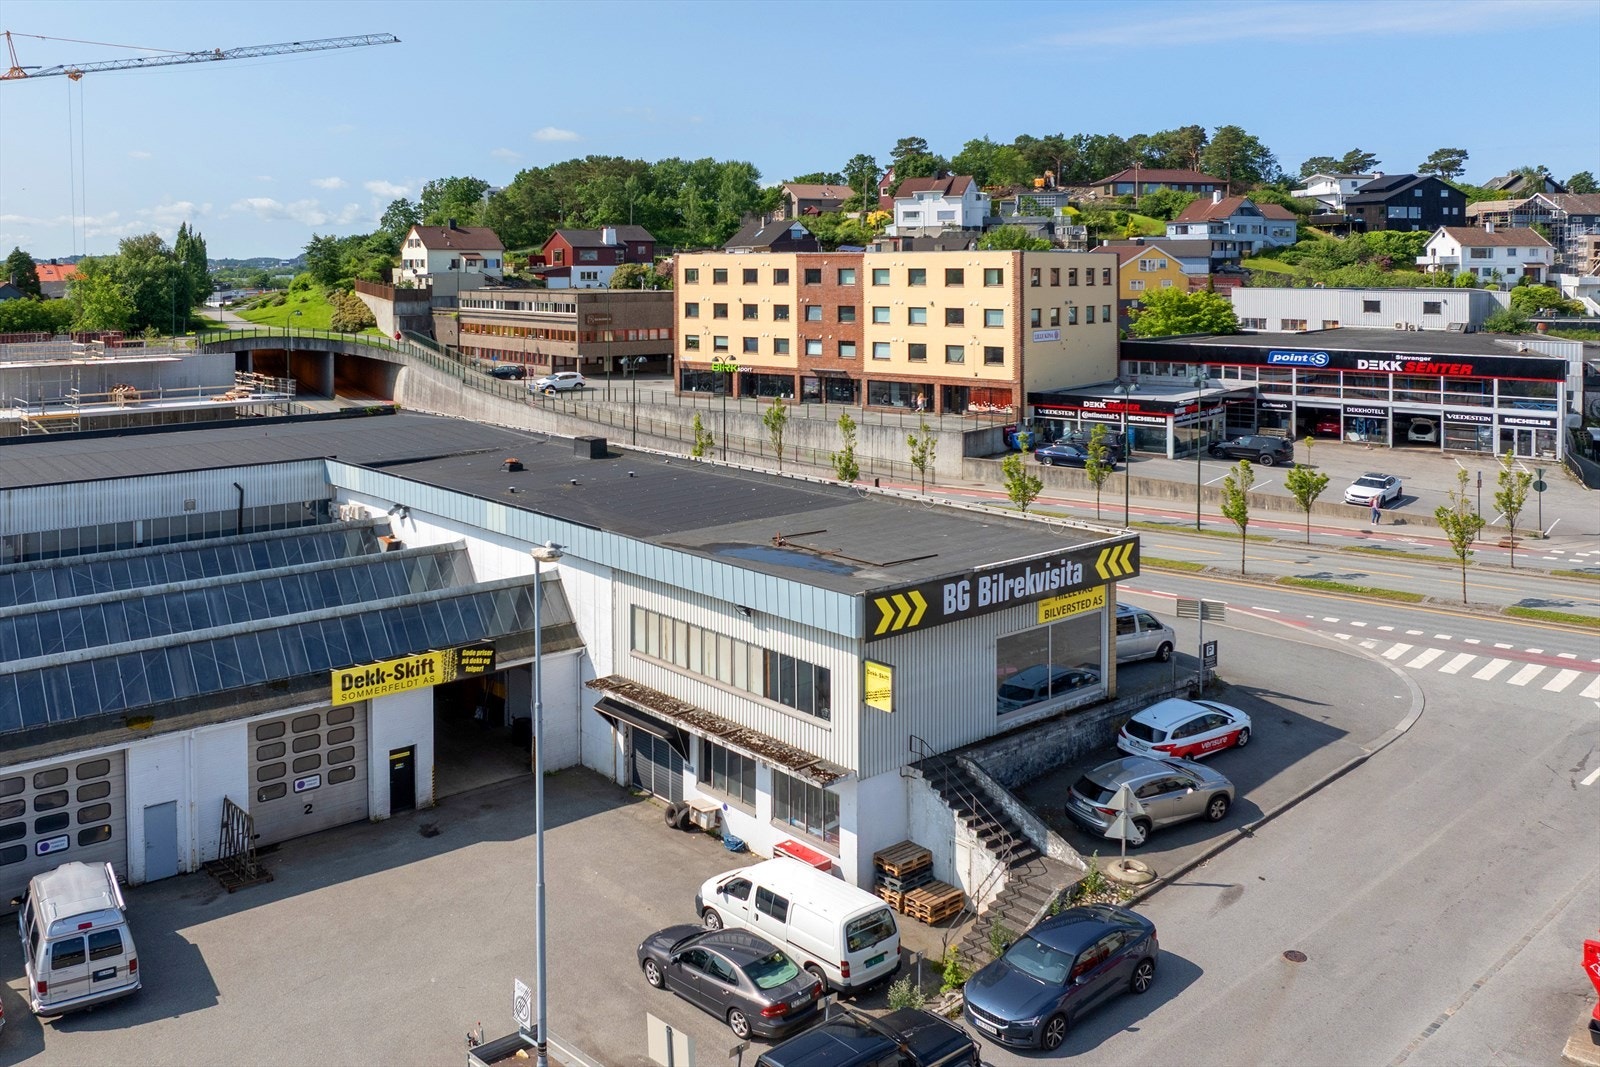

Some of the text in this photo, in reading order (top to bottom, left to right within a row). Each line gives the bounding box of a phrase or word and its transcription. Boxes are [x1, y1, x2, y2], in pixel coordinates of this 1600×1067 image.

[1273, 354, 1308, 362] point
[1357, 359, 1473, 375] DEKK SENTER
[1083, 401, 1107, 409] DEKK
[1346, 406, 1386, 415] DEKKHOTELL
[1445, 413, 1491, 422] VREDESTEIN
[1503, 417, 1551, 426] MICHELIN
[943, 558, 1083, 616] BG Bilrekvisita
[1044, 595, 1103, 619] BILVERSTED AS
[341, 658, 435, 691] Dekk-Skift
[341, 675, 435, 701] SOMMERFELDT AS
[1202, 736, 1228, 750] verisure
[303, 803, 313, 815] 2
